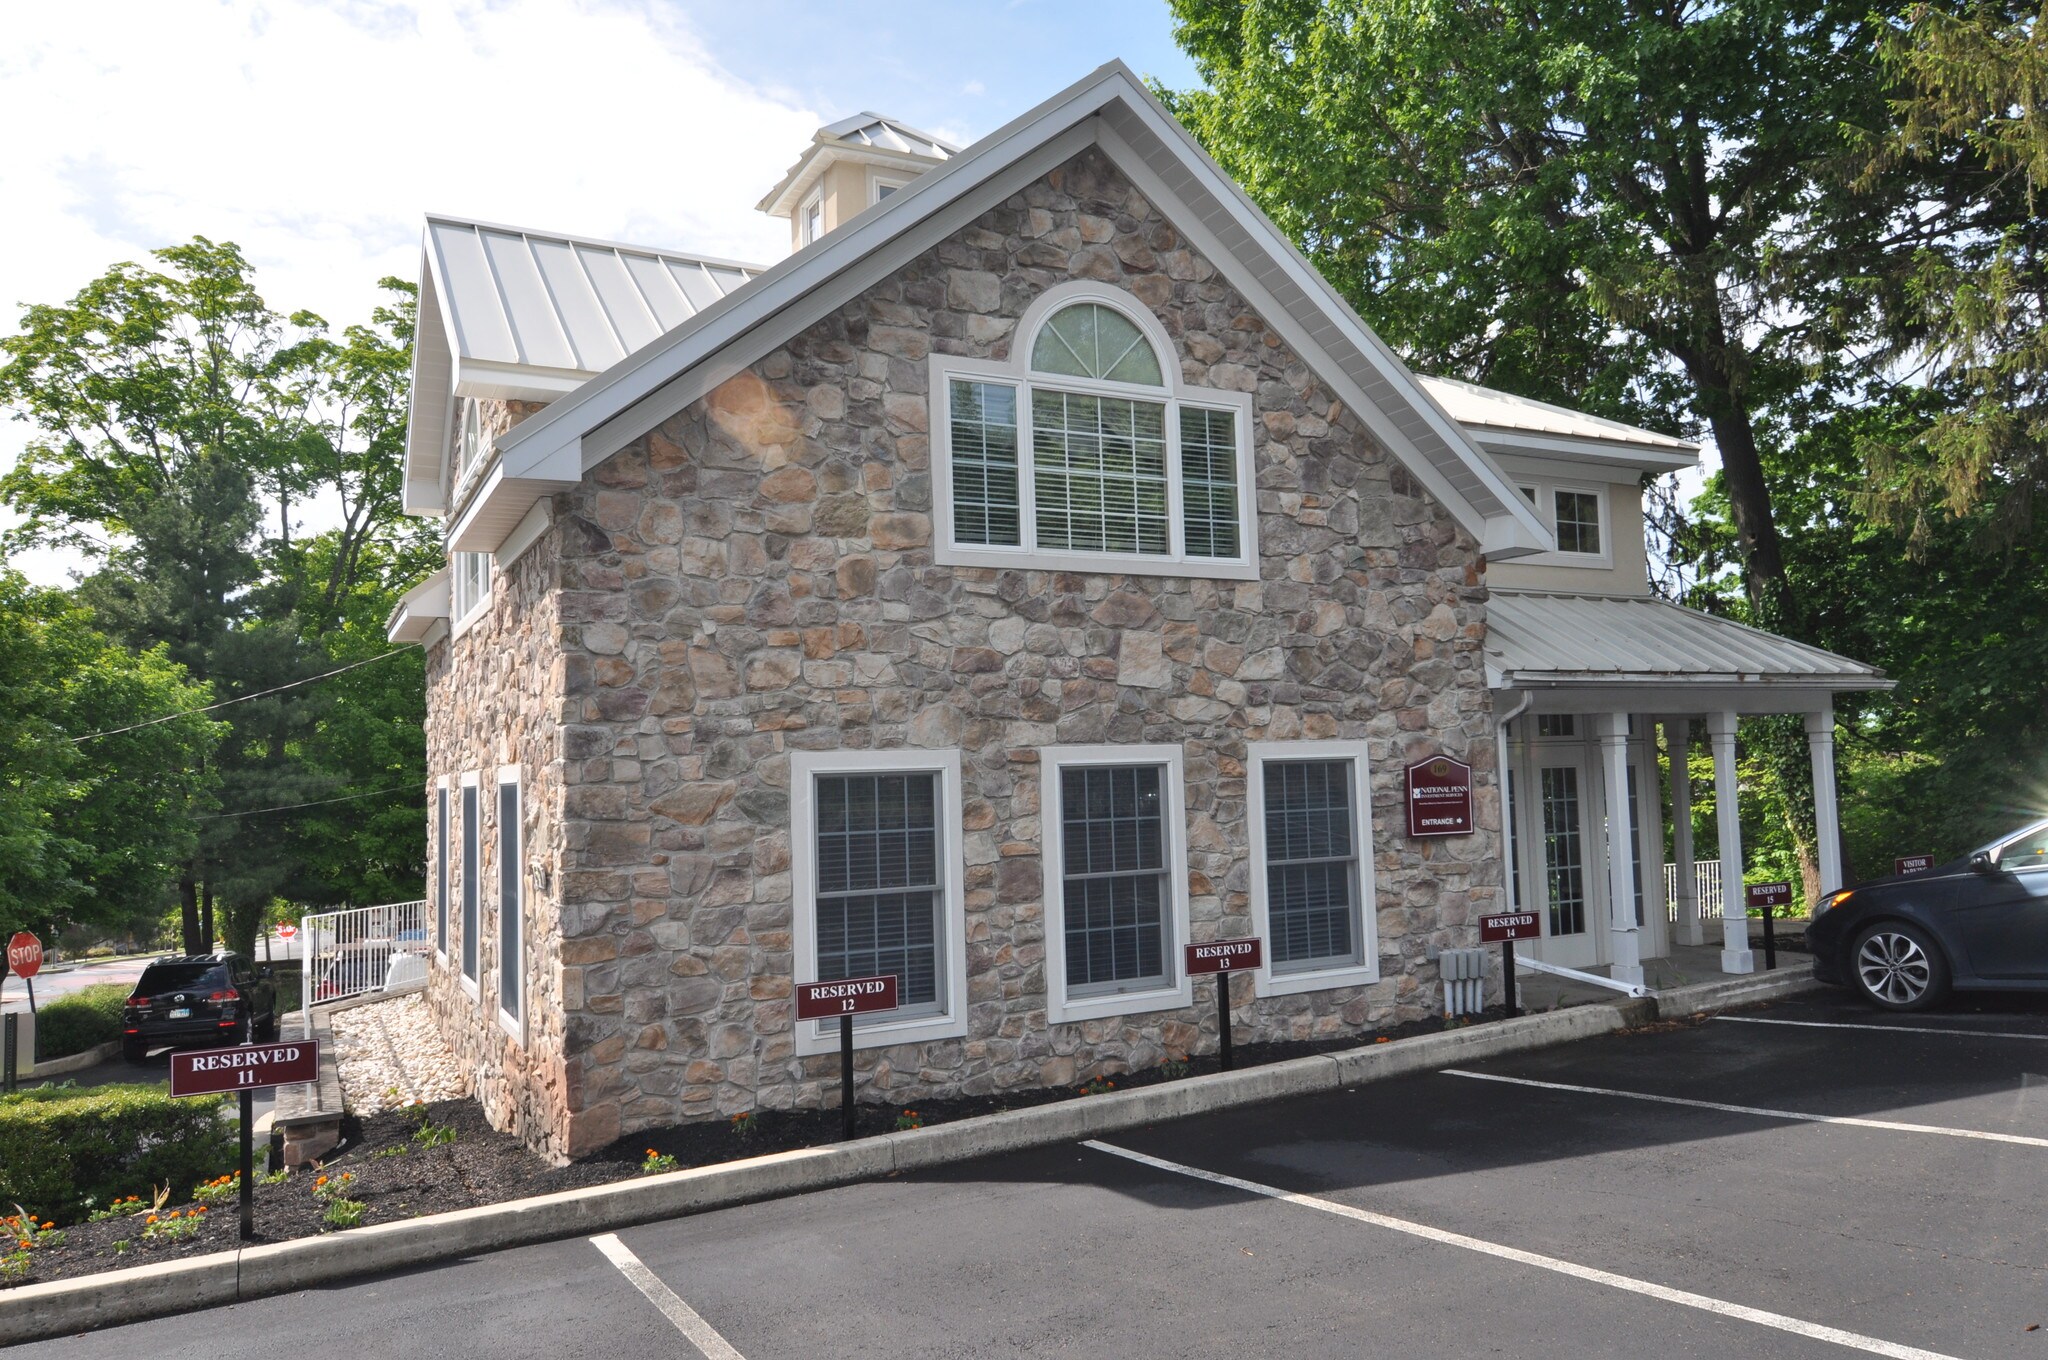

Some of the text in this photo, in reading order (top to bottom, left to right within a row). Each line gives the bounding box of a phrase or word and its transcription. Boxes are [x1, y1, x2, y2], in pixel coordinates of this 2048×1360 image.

[1421, 817, 1454, 826] ENTRANCE
[1903, 858, 1926, 868] VISITOR
[1752, 885, 1787, 896] RESERVED
[1766, 895, 1775, 904] 15
[1488, 915, 1533, 928] RESERVED
[1506, 928, 1516, 938] 14
[10, 944, 40, 966] STOP
[1195, 943, 1252, 959] RESERVED
[1219, 958, 1230, 969] 13
[810, 980, 885, 1000] RESERVED
[841, 998, 855, 1011] 12
[191, 1047, 300, 1072] RESERVED
[237, 1069, 255, 1085] 11
